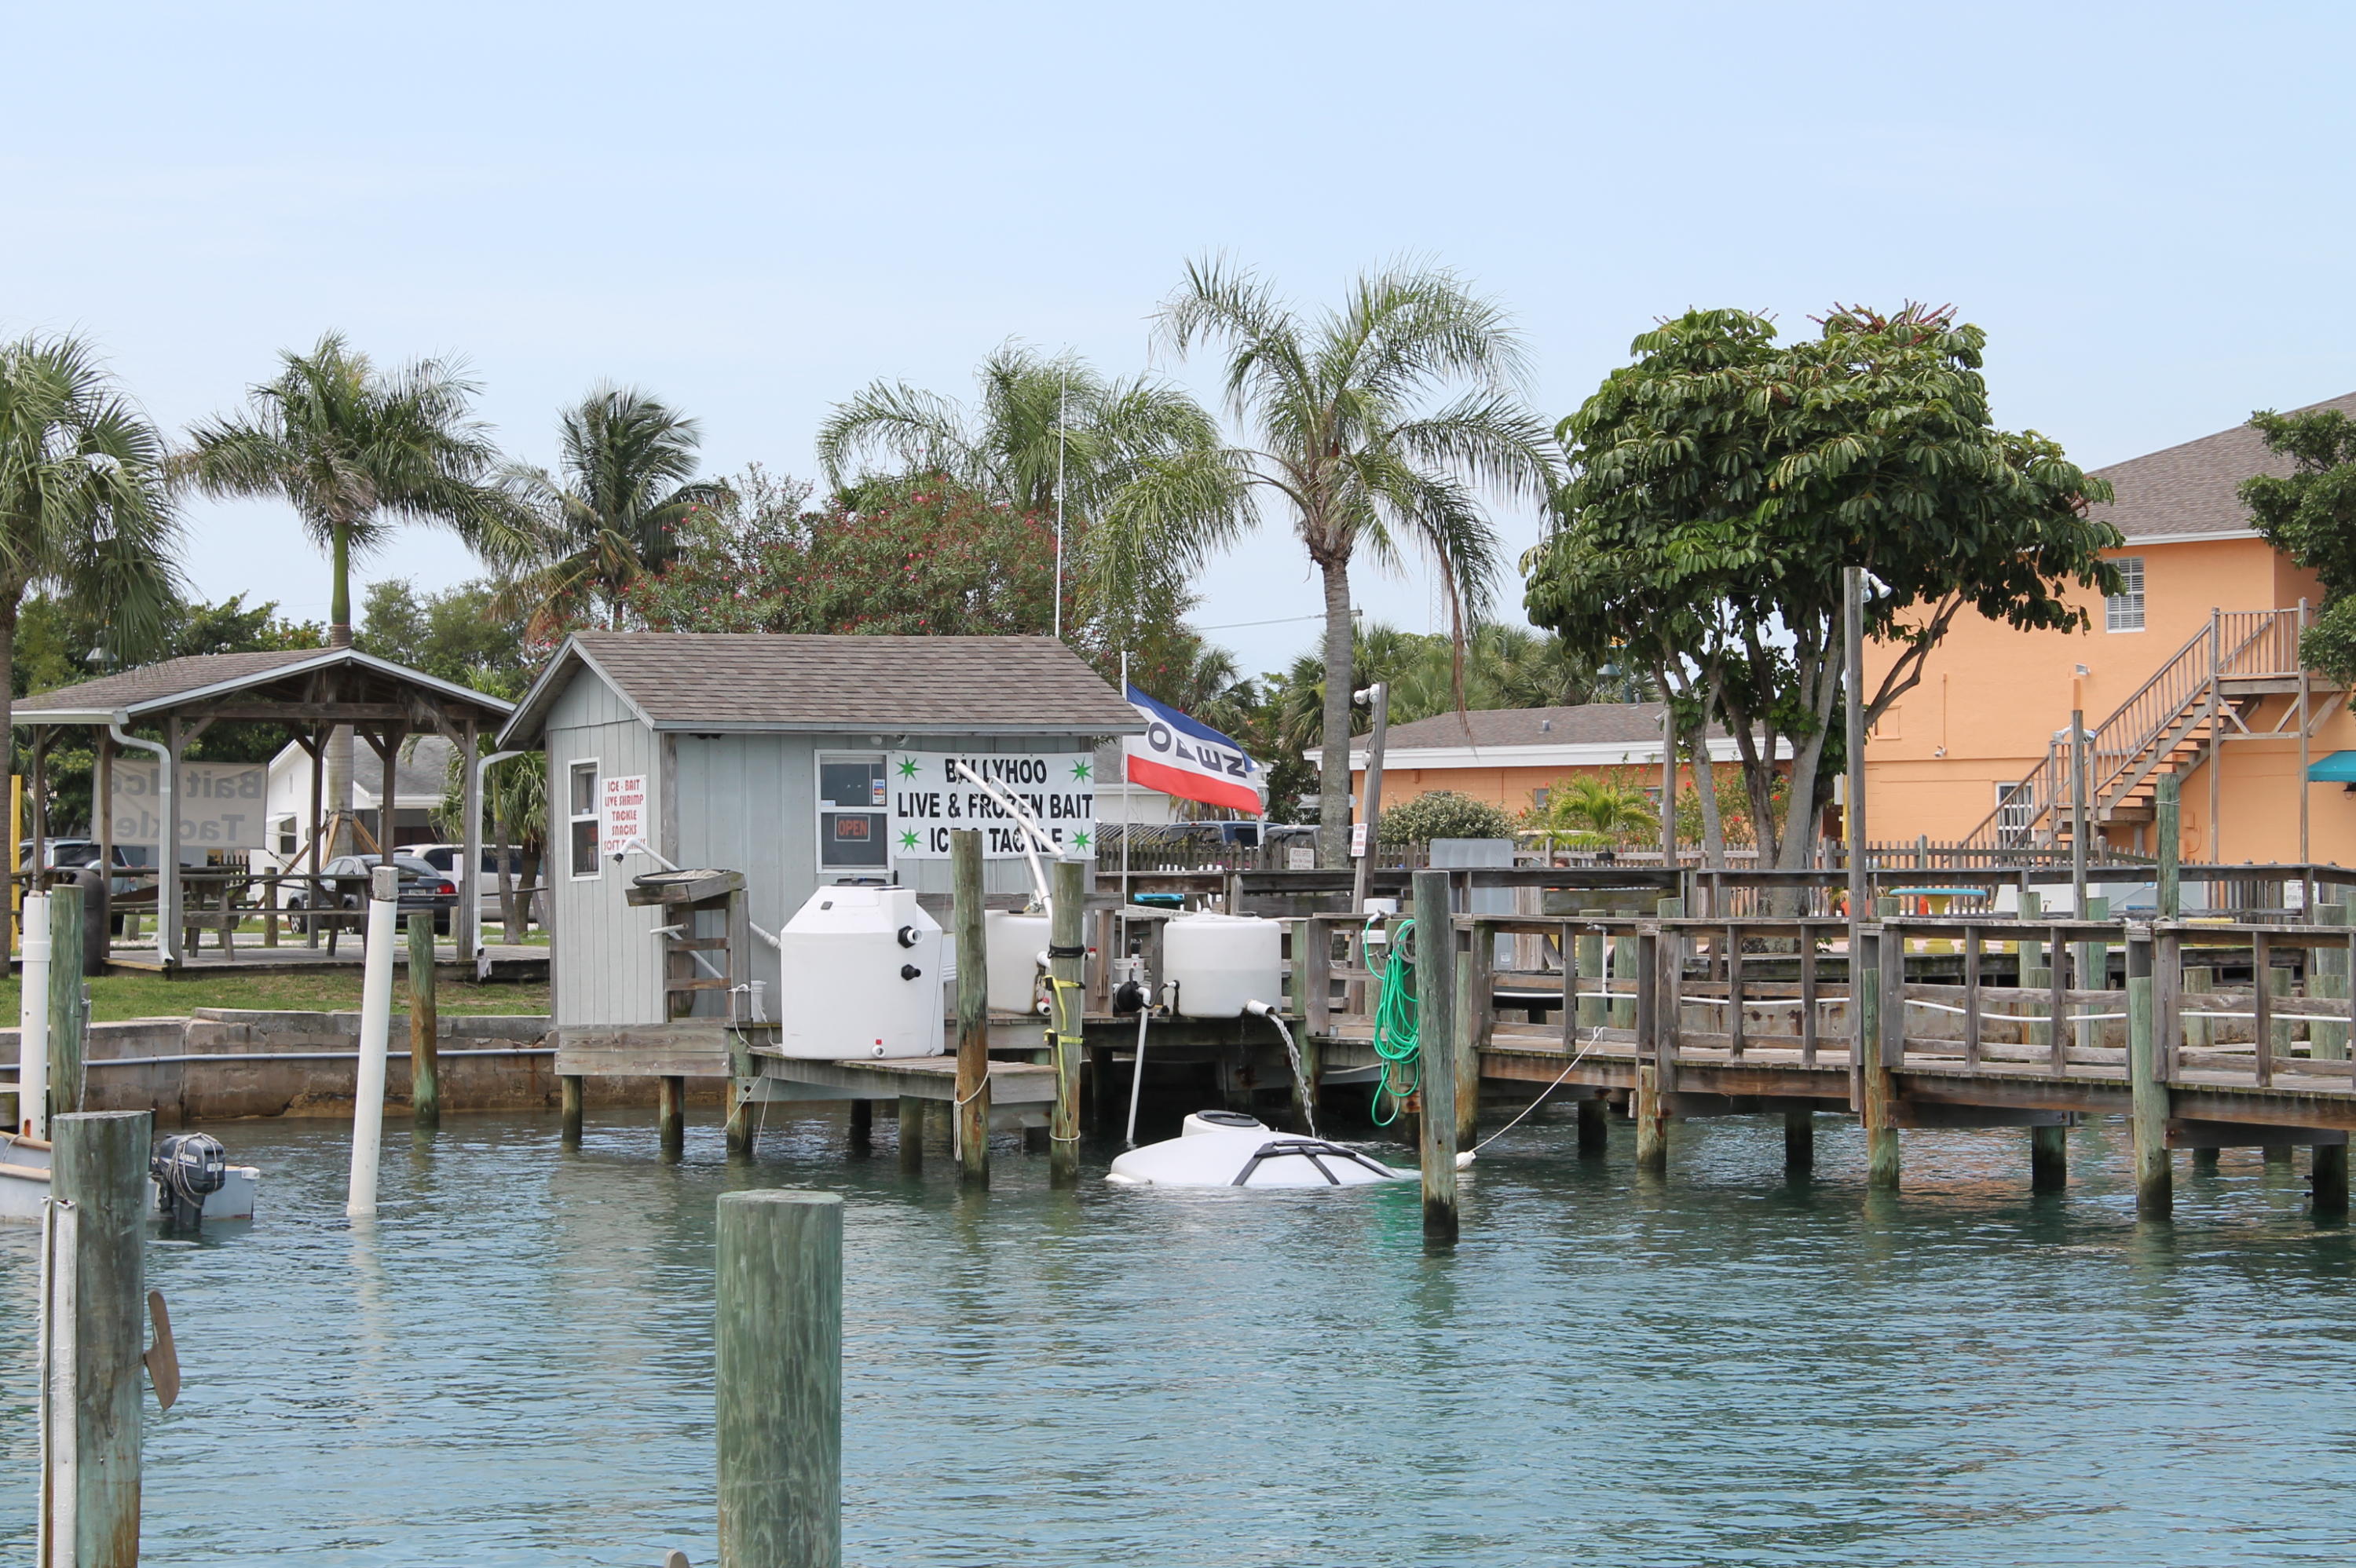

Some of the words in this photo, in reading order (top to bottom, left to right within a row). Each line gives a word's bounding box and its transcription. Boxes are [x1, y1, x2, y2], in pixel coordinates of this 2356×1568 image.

[1148, 722, 1247, 778] OPEN
[608, 780, 620, 792] ICE
[625, 779, 640, 791] BAIT
[605, 795, 617, 807] LIVE
[619, 794, 644, 806] SHRIMP
[898, 792, 940, 817] LIVE
[948, 793, 961, 818] &
[968, 793, 1043, 818] FROZEN
[1050, 794, 1092, 818] BAIT
[612, 810, 637, 821] TACKLE
[612, 824, 637, 836] SNACKS
[838, 820, 868, 836] OPEN
[603, 839, 620, 851] SOFT
[931, 828, 961, 853] IC
[989, 828, 1063, 853] TACLE
